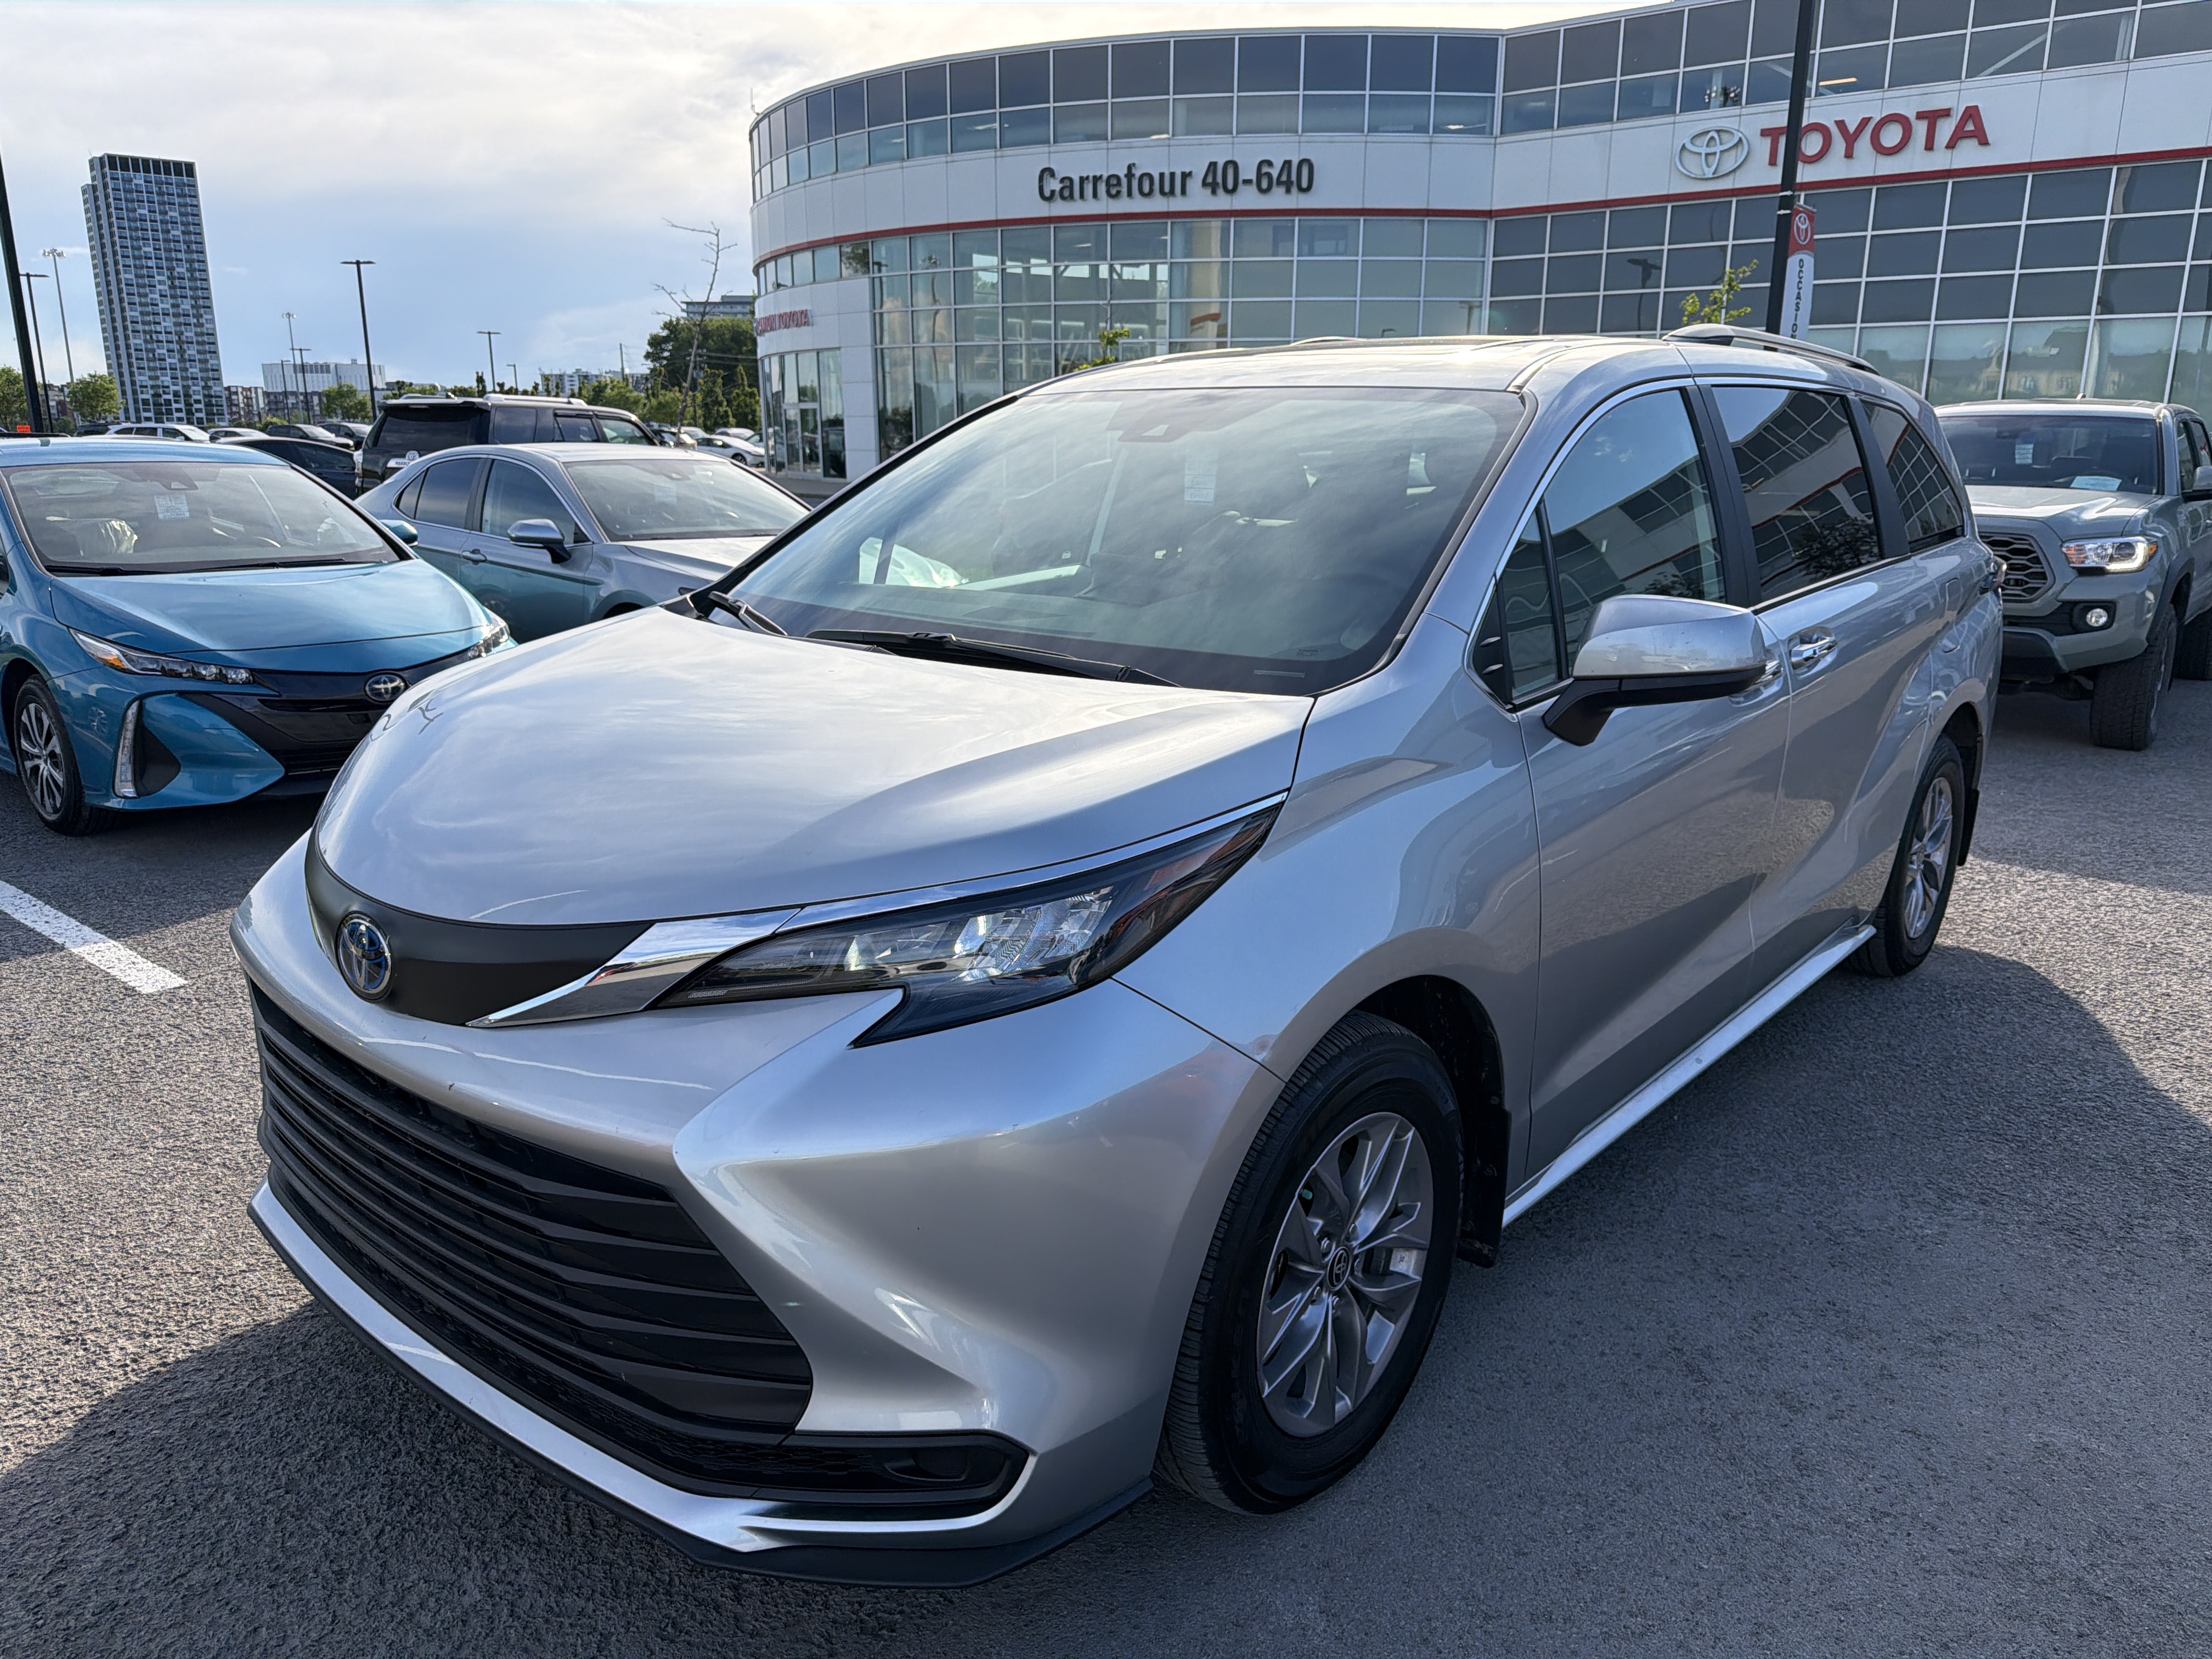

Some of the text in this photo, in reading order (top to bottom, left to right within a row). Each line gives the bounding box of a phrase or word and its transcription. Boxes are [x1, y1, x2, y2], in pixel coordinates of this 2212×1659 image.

[1760, 105, 1989, 166] TOYOTA
[1037, 158, 1315, 201] Carrefour 40-640
[777, 309, 810, 329] TOYOTA
